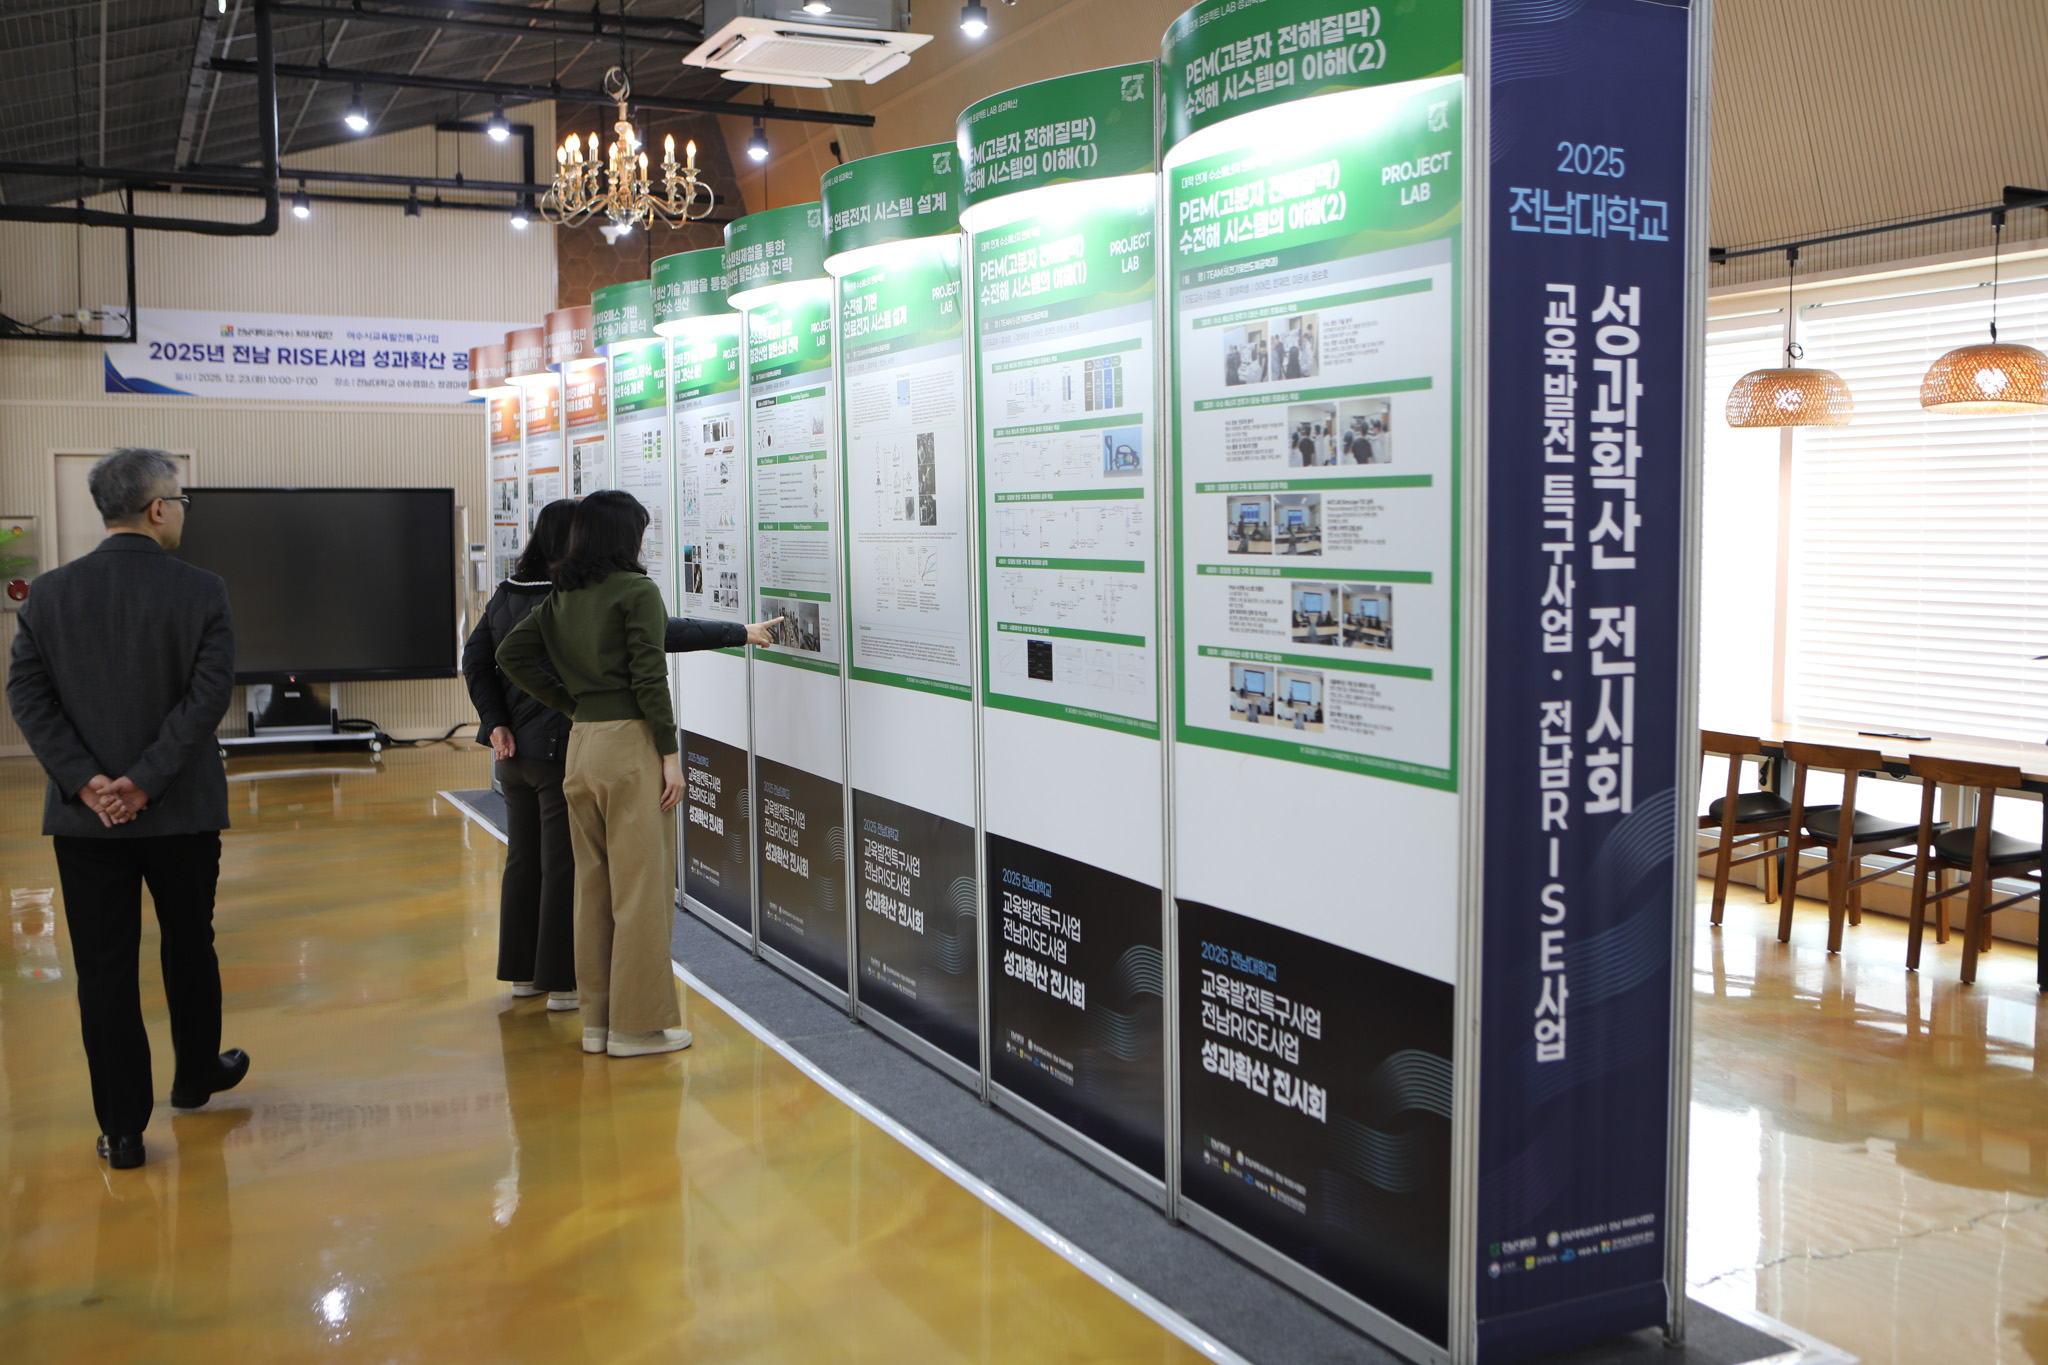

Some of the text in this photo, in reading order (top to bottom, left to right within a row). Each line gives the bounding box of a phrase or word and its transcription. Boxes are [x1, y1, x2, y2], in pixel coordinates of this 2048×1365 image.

[1221, 2, 1236, 16] LAB
[1186, 31, 1273, 89] PEM(고분자
[1278, 6, 1381, 55] 전해질막)
[1185, 39, 1386, 119] 수전해 시스템의 이해(2)
[986, 105, 998, 116] LAB
[1024, 117, 1096, 149] 전해질막)
[963, 143, 1098, 196] 수전해 시스템의 이해(1)
[1381, 151, 1452, 186] PROJECT
[1557, 141, 1625, 178] 2025
[834, 192, 947, 231] 연료전지 시스템 설계
[1179, 179, 1265, 226] PEM(고분자
[1400, 182, 1431, 206] LAB
[1179, 191, 1347, 255] 수전해 시스템의 이해(2)
[1508, 187, 1669, 242] 전남대학교
[765, 238, 785, 258] 통한
[1109, 231, 1151, 257] PROJECT
[739, 260, 769, 283] 탈탄소화
[772, 257, 793, 275] 전략
[980, 248, 1038, 282] PEM(고분자
[980, 259, 1087, 306] 수전해 시스템의 이해(1)
[1121, 255, 1139, 274] LAB
[667, 282, 681, 298] 기술
[682, 278, 708, 295] 개발을
[674, 296, 689, 312] 생산
[931, 281, 960, 301] PROJECT
[622, 305, 638, 320] 기반
[940, 300, 953, 315] LAB
[614, 321, 628, 335] 기술
[630, 319, 647, 333] 분석
[816, 334, 826, 347] LAB
[149, 342, 225, 363] 2025년
[232, 344, 271, 364] 전남
[277, 347, 365, 368] RISE사업
[372, 350, 446, 370] 성과확산
[1584, 285, 1643, 814] 성과확산 전시회
[764, 798, 806, 830] 교육발전특구사업
[764, 817, 799, 847] 전남RISE사업
[765, 841, 809, 879] 성과확산 전시회
[864, 837, 921, 878] 교육발전특구사업
[864, 860, 911, 897] 전남RISE사업
[1002, 868, 1052, 898] 2025 전남대학교
[1534, 700, 1573, 1063] 전남RISE사업
[864, 887, 924, 935] 성과확산 전시회
[1003, 890, 1081, 943] 교육발전특구사업
[1003, 917, 1067, 965] 전남RISE사업
[1003, 948, 1086, 1011] 성과확산 전시회
[1201, 940, 1277, 983] 2025 전남대학교
[1201, 968, 1321, 1040] 교육발전특구사업
[1201, 999, 1299, 1066] 전남RISE사업
[1201, 1038, 1327, 1124] 성과확산 전시회
